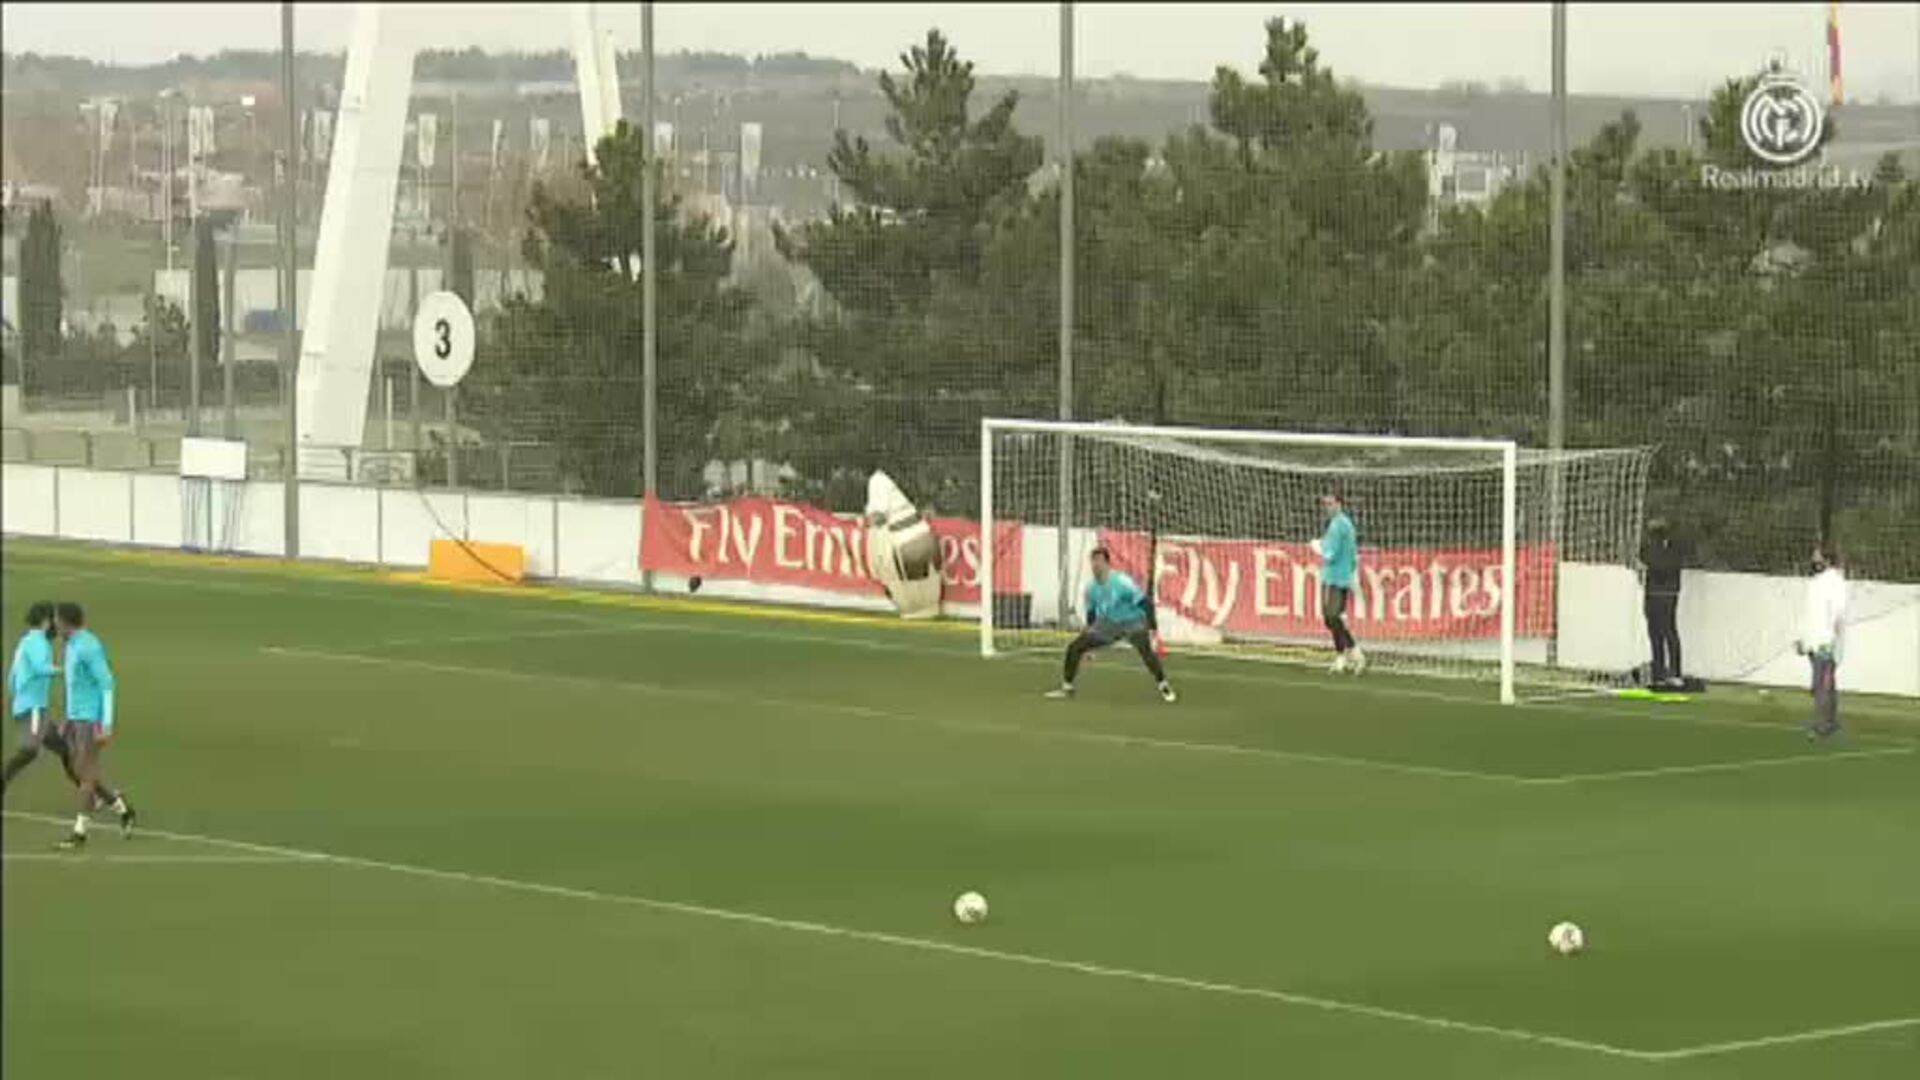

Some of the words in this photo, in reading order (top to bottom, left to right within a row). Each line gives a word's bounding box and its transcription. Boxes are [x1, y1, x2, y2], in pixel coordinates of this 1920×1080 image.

[434, 318, 451, 360] 3
[682, 505, 763, 577] Fly
[1154, 544, 1240, 626] Fly
